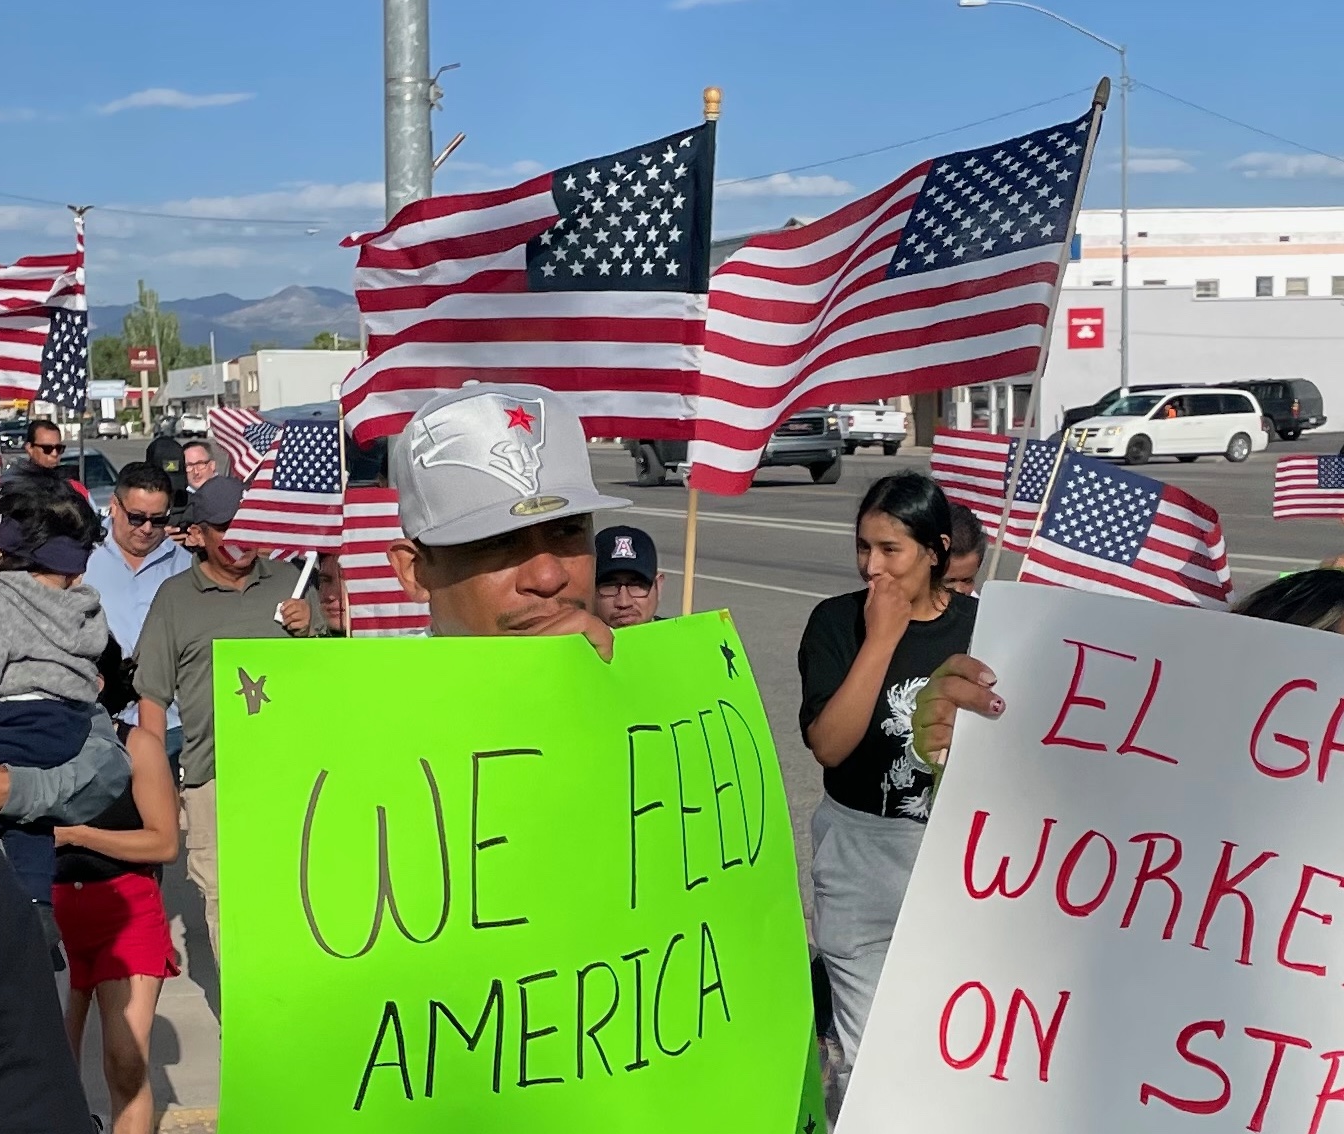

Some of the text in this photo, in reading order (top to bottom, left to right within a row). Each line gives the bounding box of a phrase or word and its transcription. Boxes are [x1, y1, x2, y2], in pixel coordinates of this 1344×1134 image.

[1041, 638, 1179, 766] EL
[299, 699, 767, 960] WE FEED
[353, 921, 733, 1111] AMERICA
[939, 981, 1072, 1084] ON
